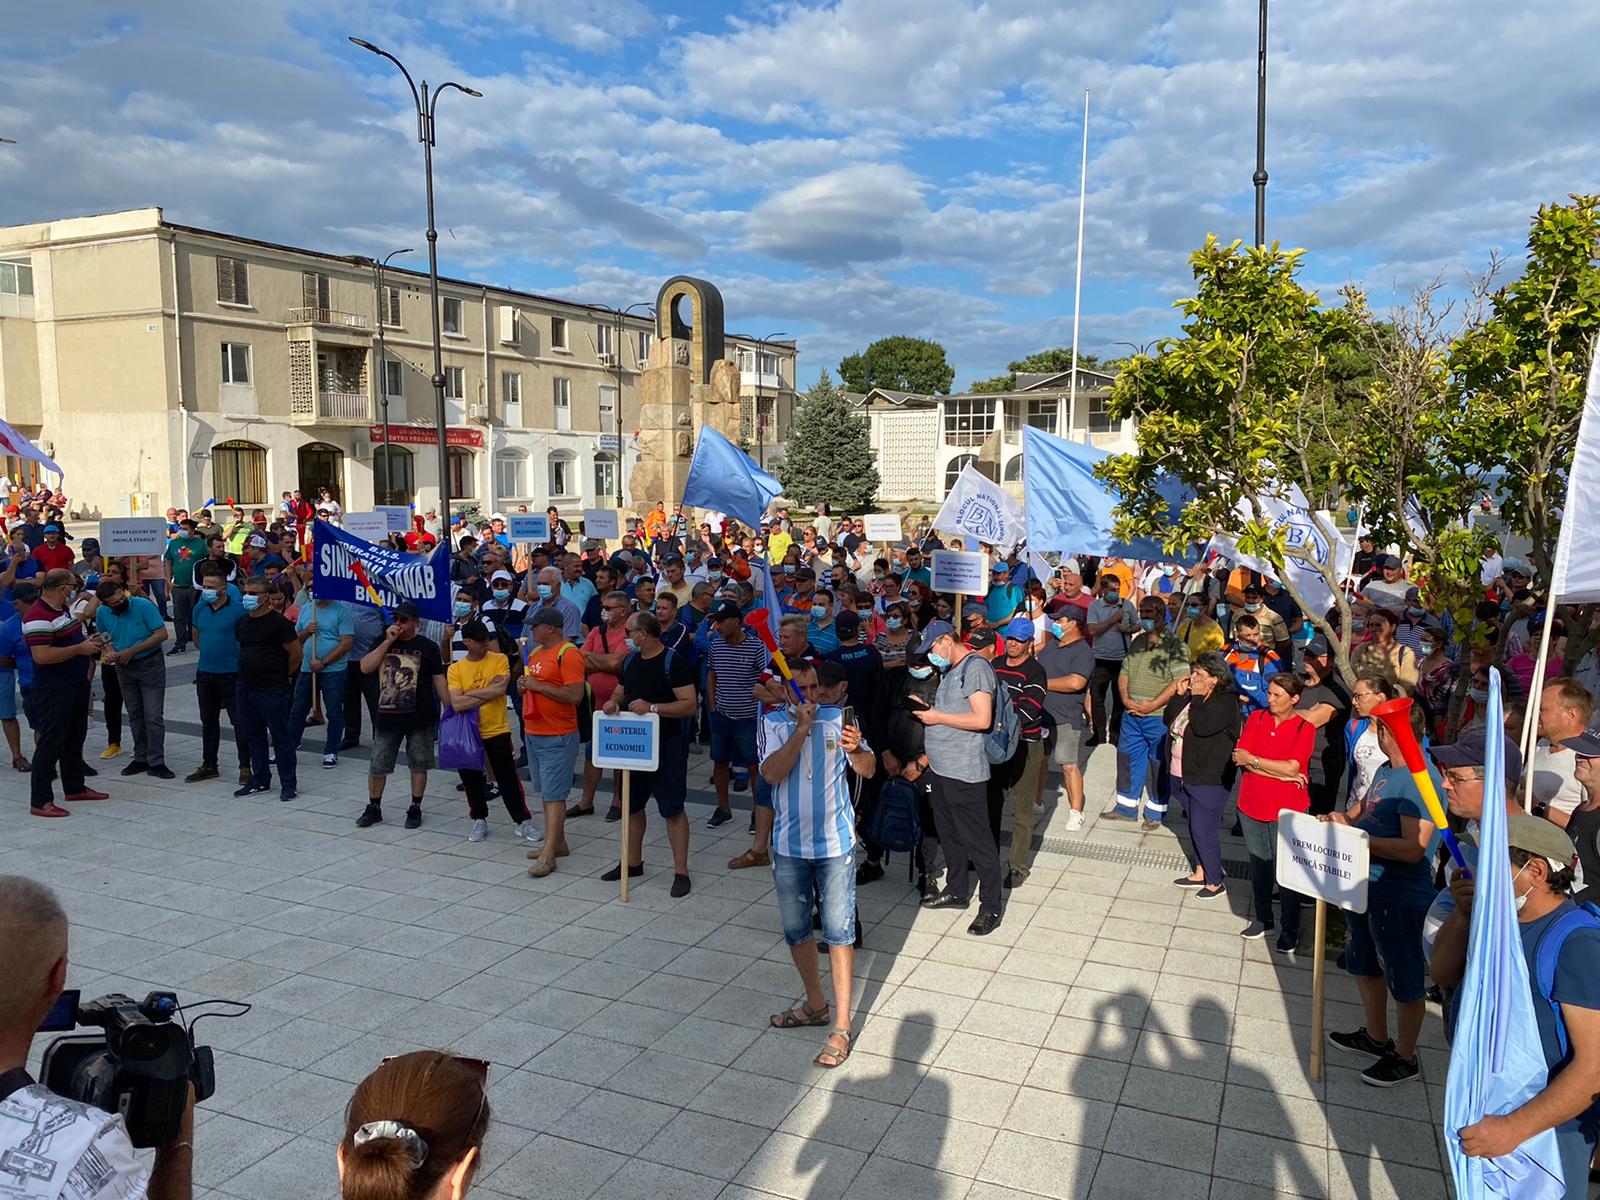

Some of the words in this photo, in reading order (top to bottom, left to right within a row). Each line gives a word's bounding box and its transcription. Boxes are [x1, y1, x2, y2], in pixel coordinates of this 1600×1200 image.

[956, 496, 975, 524] BLOCUL
[1270, 513, 1287, 536] OCUL
[368, 545, 400, 560] B.N.S.
[604, 726, 647, 736] MINISTERUL
[605, 743, 645, 752] ECONOMIEI
[1292, 838, 1312, 851] VREM
[1313, 844, 1340, 859] LOCURI
[1342, 852, 1353, 863] DE
[1292, 855, 1317, 869] MUNCĂ
[1318, 863, 1351, 880] STABILE!
